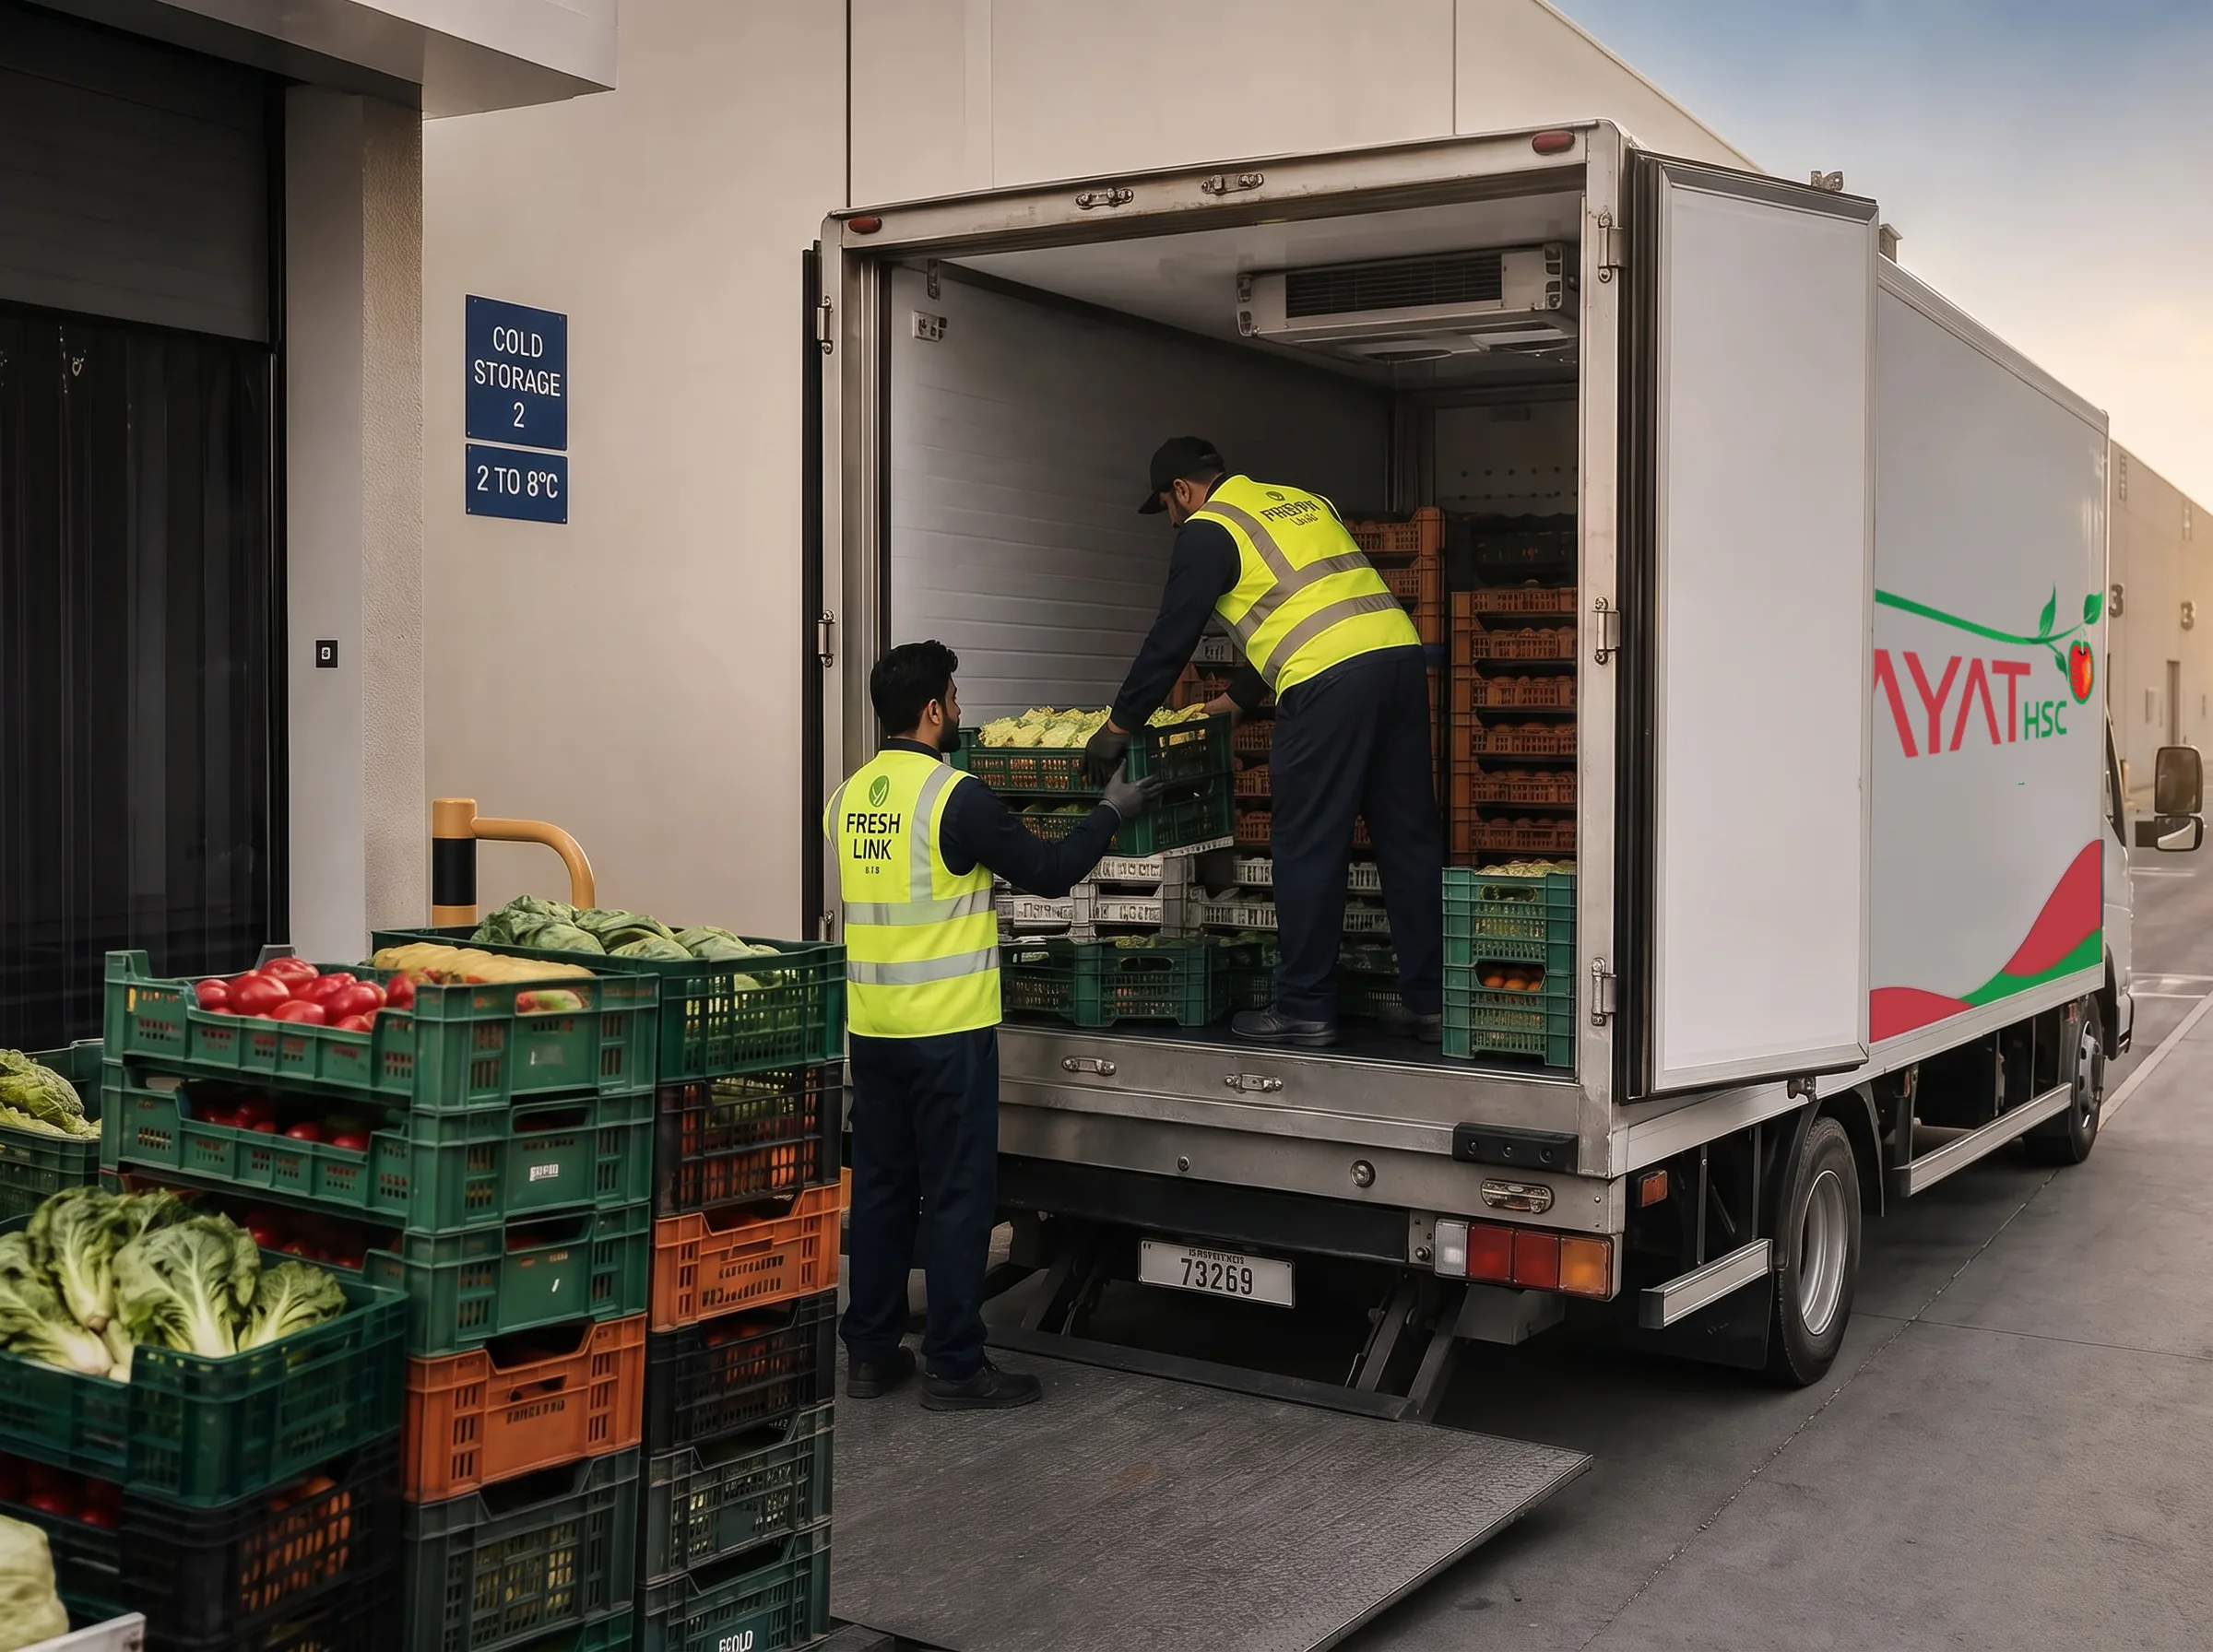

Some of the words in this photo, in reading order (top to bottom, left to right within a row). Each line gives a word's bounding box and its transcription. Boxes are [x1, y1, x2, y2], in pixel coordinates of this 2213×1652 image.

[493, 326, 542, 358] COLD
[474, 360, 561, 396] STORAGE
[514, 402, 525, 428] 2
[477, 465, 489, 491] 2
[494, 466, 520, 495] TO
[2024, 701, 2067, 740] HSC
[846, 813, 901, 834] FRESH
[853, 839, 892, 860] LINK
[1180, 1257, 1253, 1295] 73269
